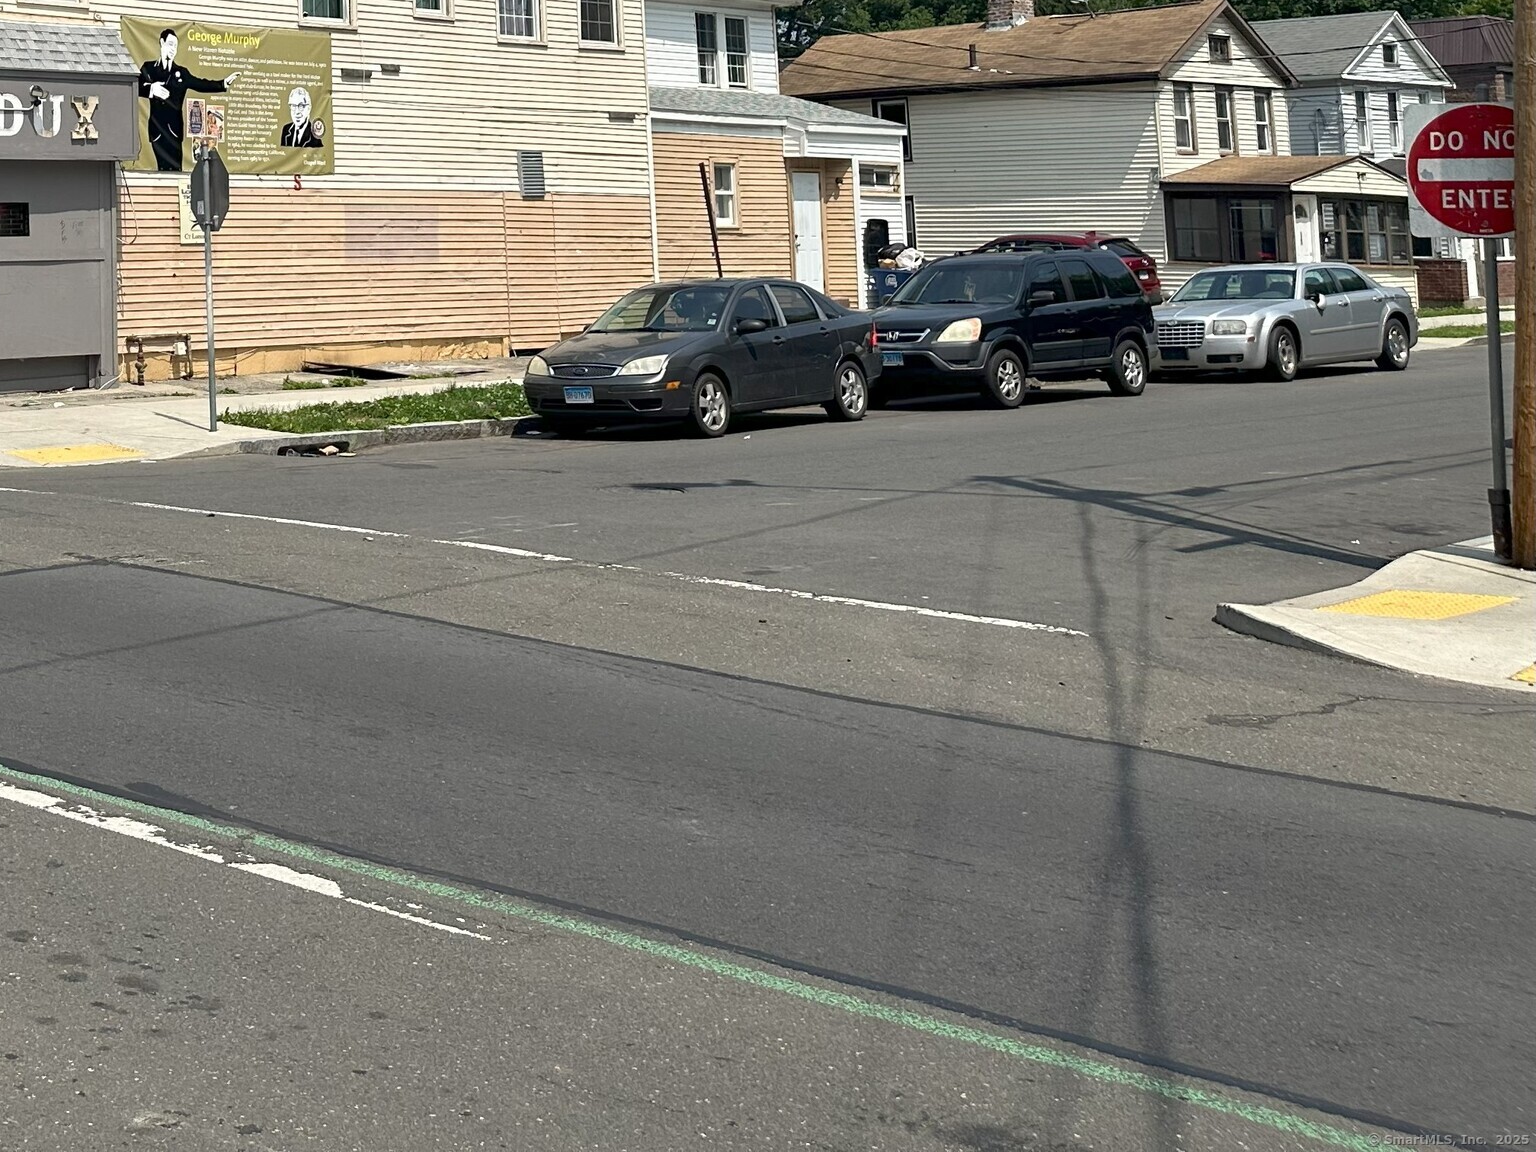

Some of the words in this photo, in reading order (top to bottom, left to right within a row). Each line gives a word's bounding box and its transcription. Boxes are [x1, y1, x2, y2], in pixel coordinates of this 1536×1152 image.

[187, 29, 222, 46] George
[224, 32, 261, 49] Murphy
[1430, 131, 1464, 151] DO
[1484, 130, 1514, 150] NO
[1442, 188, 1514, 209] ENTE
